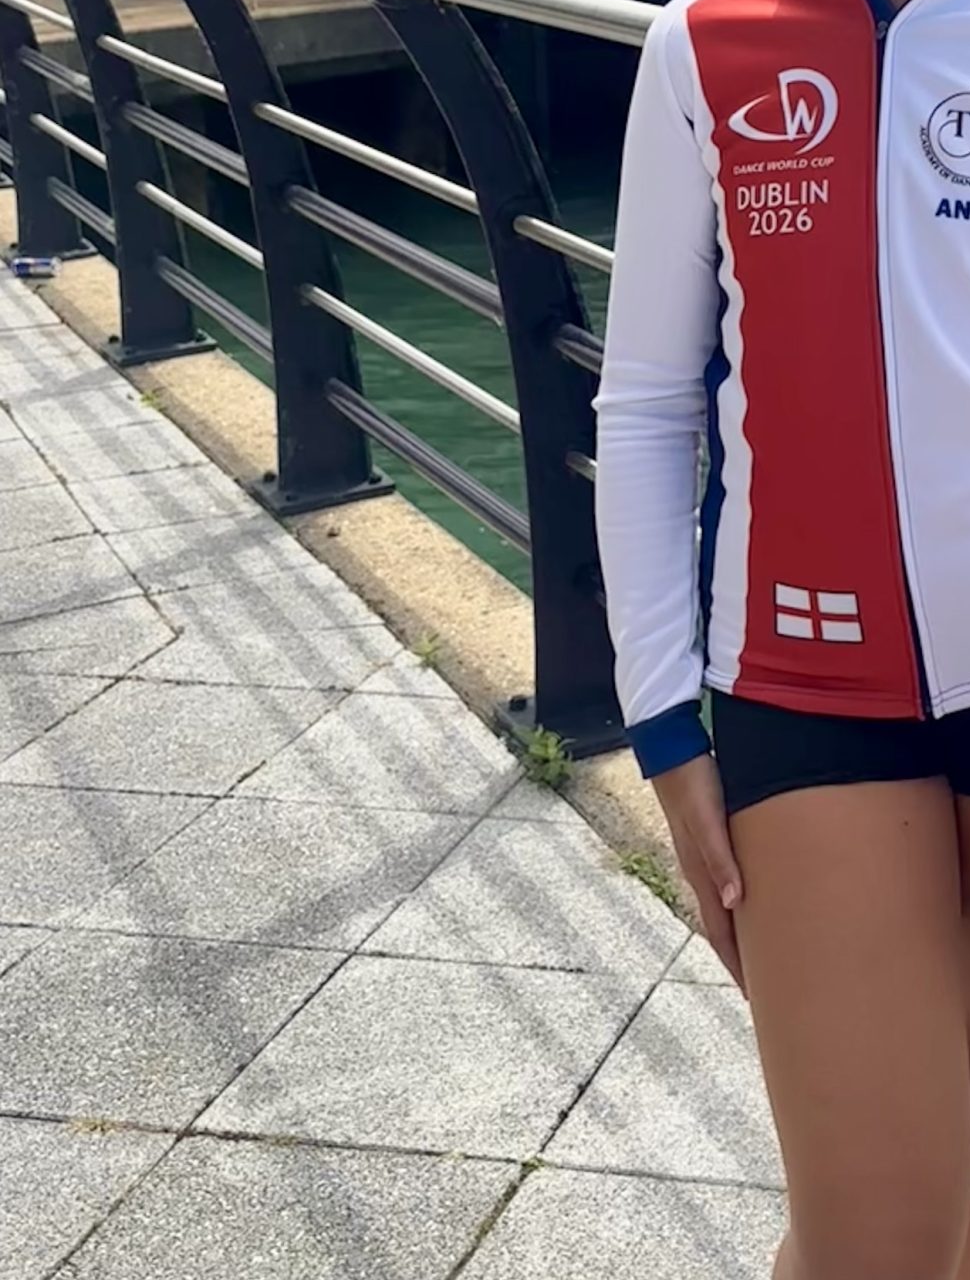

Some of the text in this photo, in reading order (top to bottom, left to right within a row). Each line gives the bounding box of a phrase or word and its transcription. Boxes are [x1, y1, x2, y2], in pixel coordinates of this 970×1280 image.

[732, 155, 835, 176] DANCE WORLD CUP
[737, 178, 829, 211] DUBLIN
[749, 207, 813, 237] 2026
